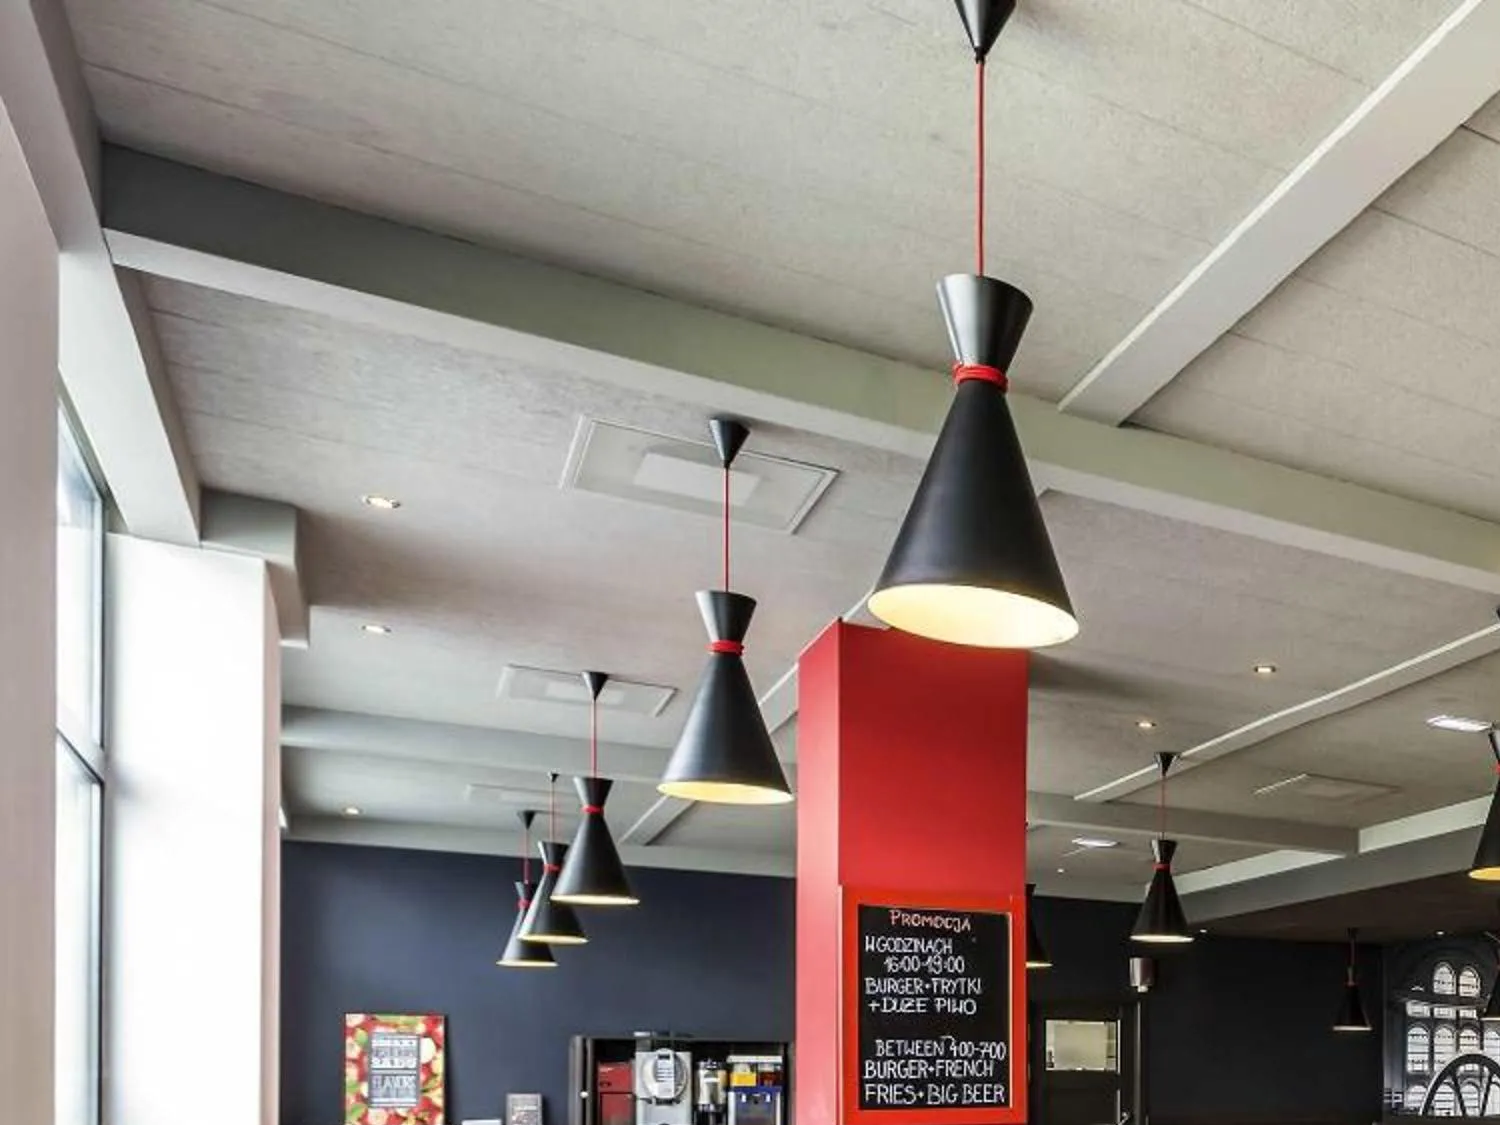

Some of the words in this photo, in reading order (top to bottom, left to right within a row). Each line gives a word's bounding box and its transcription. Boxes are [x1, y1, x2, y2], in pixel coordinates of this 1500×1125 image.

[875, 1039, 944, 1057] BETWEEN
[864, 1084, 916, 1104] FRIES
[927, 1084, 960, 1105] BIG
[961, 1084, 1005, 1104] BEER
